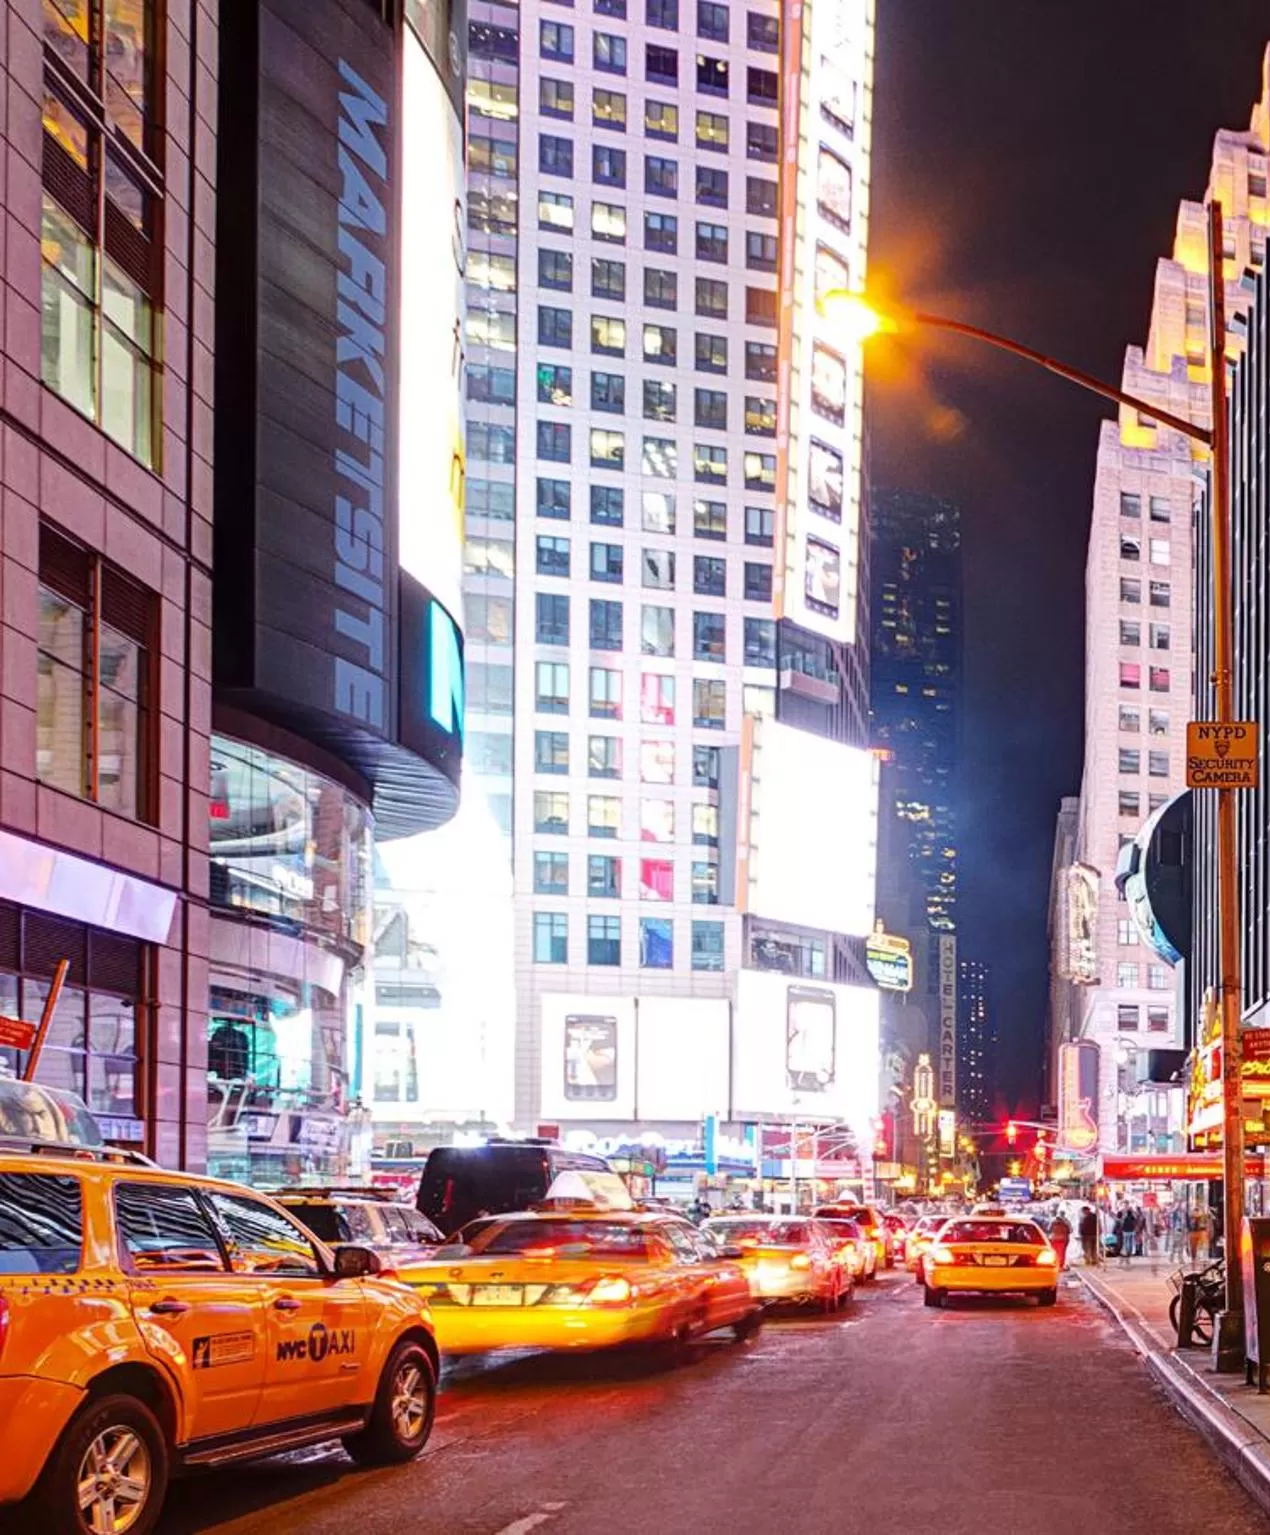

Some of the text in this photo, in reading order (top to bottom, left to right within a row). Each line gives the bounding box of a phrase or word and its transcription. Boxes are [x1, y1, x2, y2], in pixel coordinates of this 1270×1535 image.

[333, 57, 389, 730] MARKETSITE
[1198, 726, 1247, 739] NYPD
[943, 1016, 954, 1096] CARTER
[277, 1341, 307, 1361] NYC
